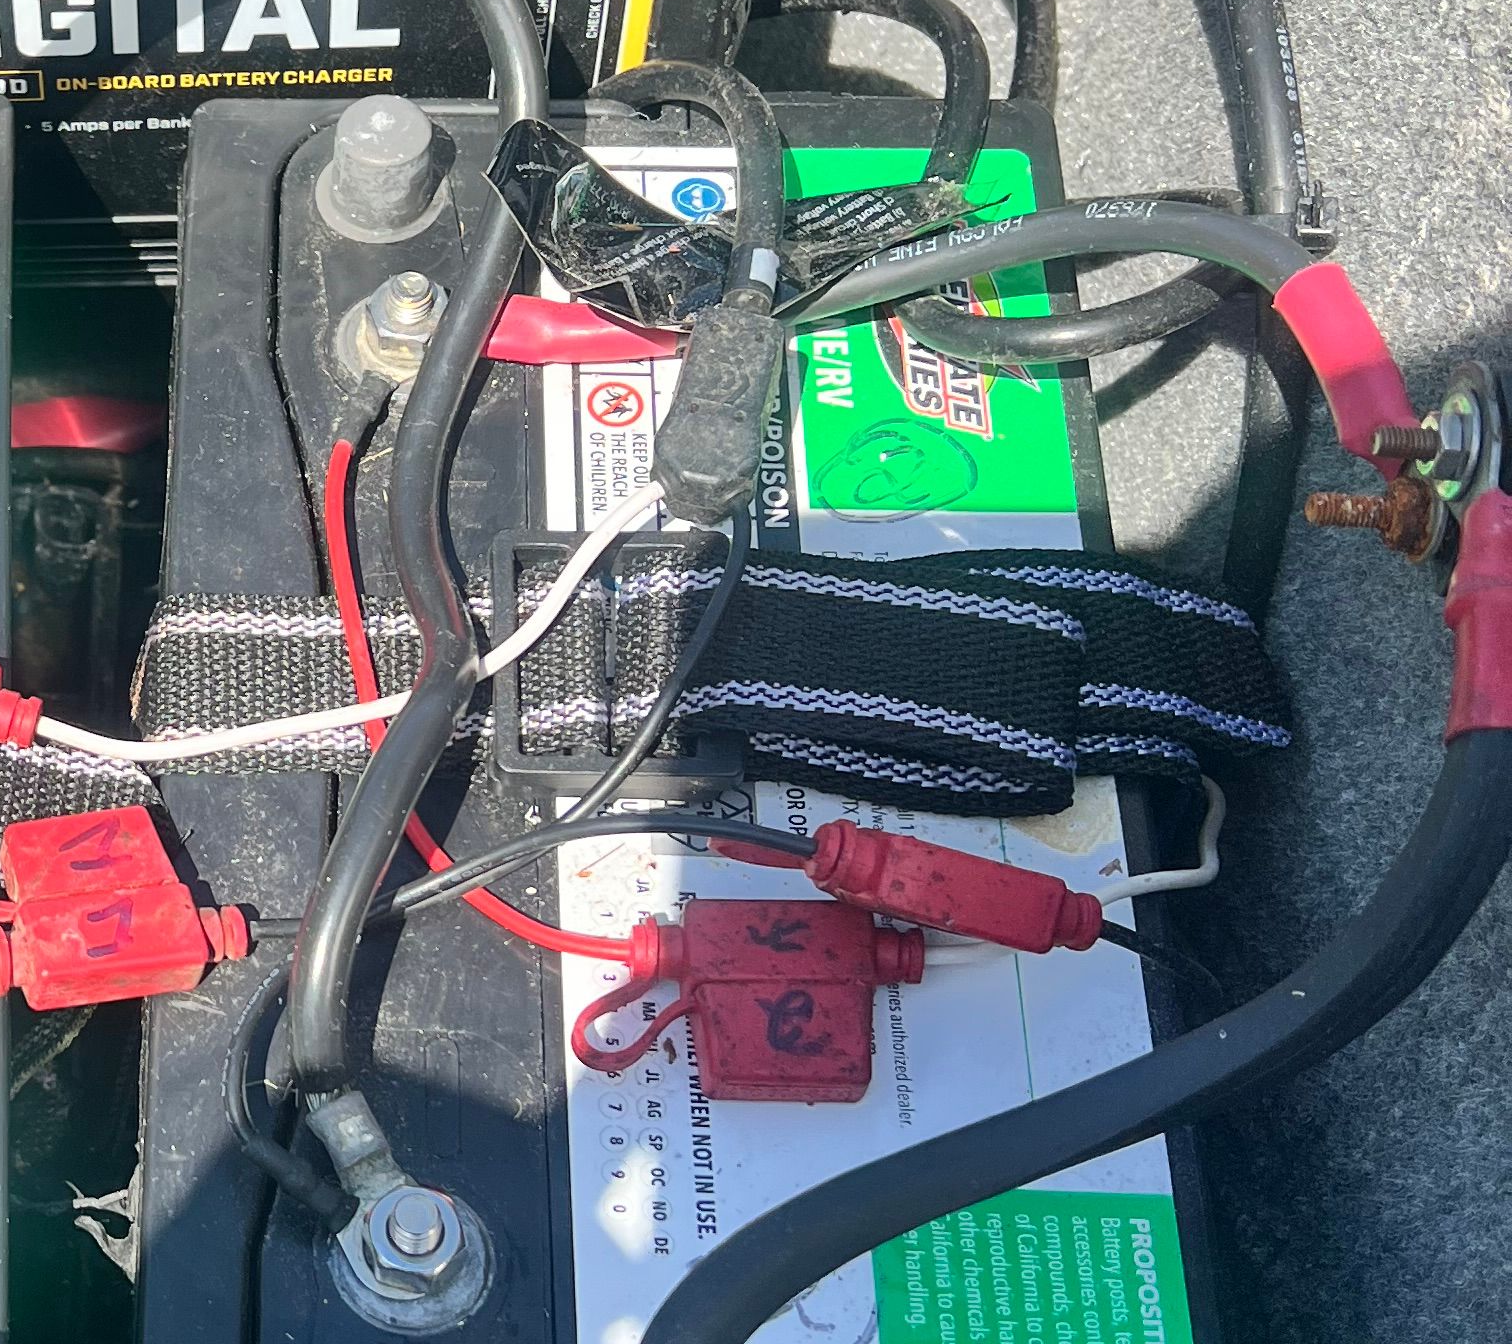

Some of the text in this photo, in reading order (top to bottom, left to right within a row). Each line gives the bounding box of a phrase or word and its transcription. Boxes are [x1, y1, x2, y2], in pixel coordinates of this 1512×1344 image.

[586, 0, 601, 39] CHECK
[55, 67, 393, 92] ON-BOARD BATTERY CHARGER
[41, 117, 192, 134] 5 Amps per Bank
[590, 432, 605, 448] OF
[632, 433, 648, 463] KEEP
[611, 431, 628, 498] THE REACH
[636, 877, 650, 894] JA
[644, 1069, 660, 1084] JL
[891, 1014, 913, 1130] authorized dealer.
[608, 1102, 623, 1112] 7
[645, 1099, 662, 1119] AG
[609, 1135, 624, 1146] 8
[648, 1134, 663, 1151] SP
[692, 1132, 713, 1171] NOT
[611, 1169, 625, 1180] 9
[650, 1167, 666, 1187] OC
[693, 1175, 714, 1194] IN
[651, 1201, 667, 1221] NO
[695, 1199, 717, 1241] USE.
[1014, 1213, 1037, 1231] of
[957, 1211, 979, 1255] other
[653, 1237, 669, 1255] DE
[930, 1213, 953, 1289] alifornia
[1100, 1217, 1122, 1275] Battery
[983, 1213, 1012, 1317] reproductive
[1017, 1233, 1042, 1313] California
[1042, 1215, 1074, 1317] compounds,
[1071, 1215, 1097, 1307] accessories
[902, 1250, 930, 1329] handling.
[938, 1293, 954, 1309] to
[963, 1258, 991, 1342] chemicals
[1103, 1278, 1130, 1327] posts,
[1026, 1317, 1045, 1333] to
